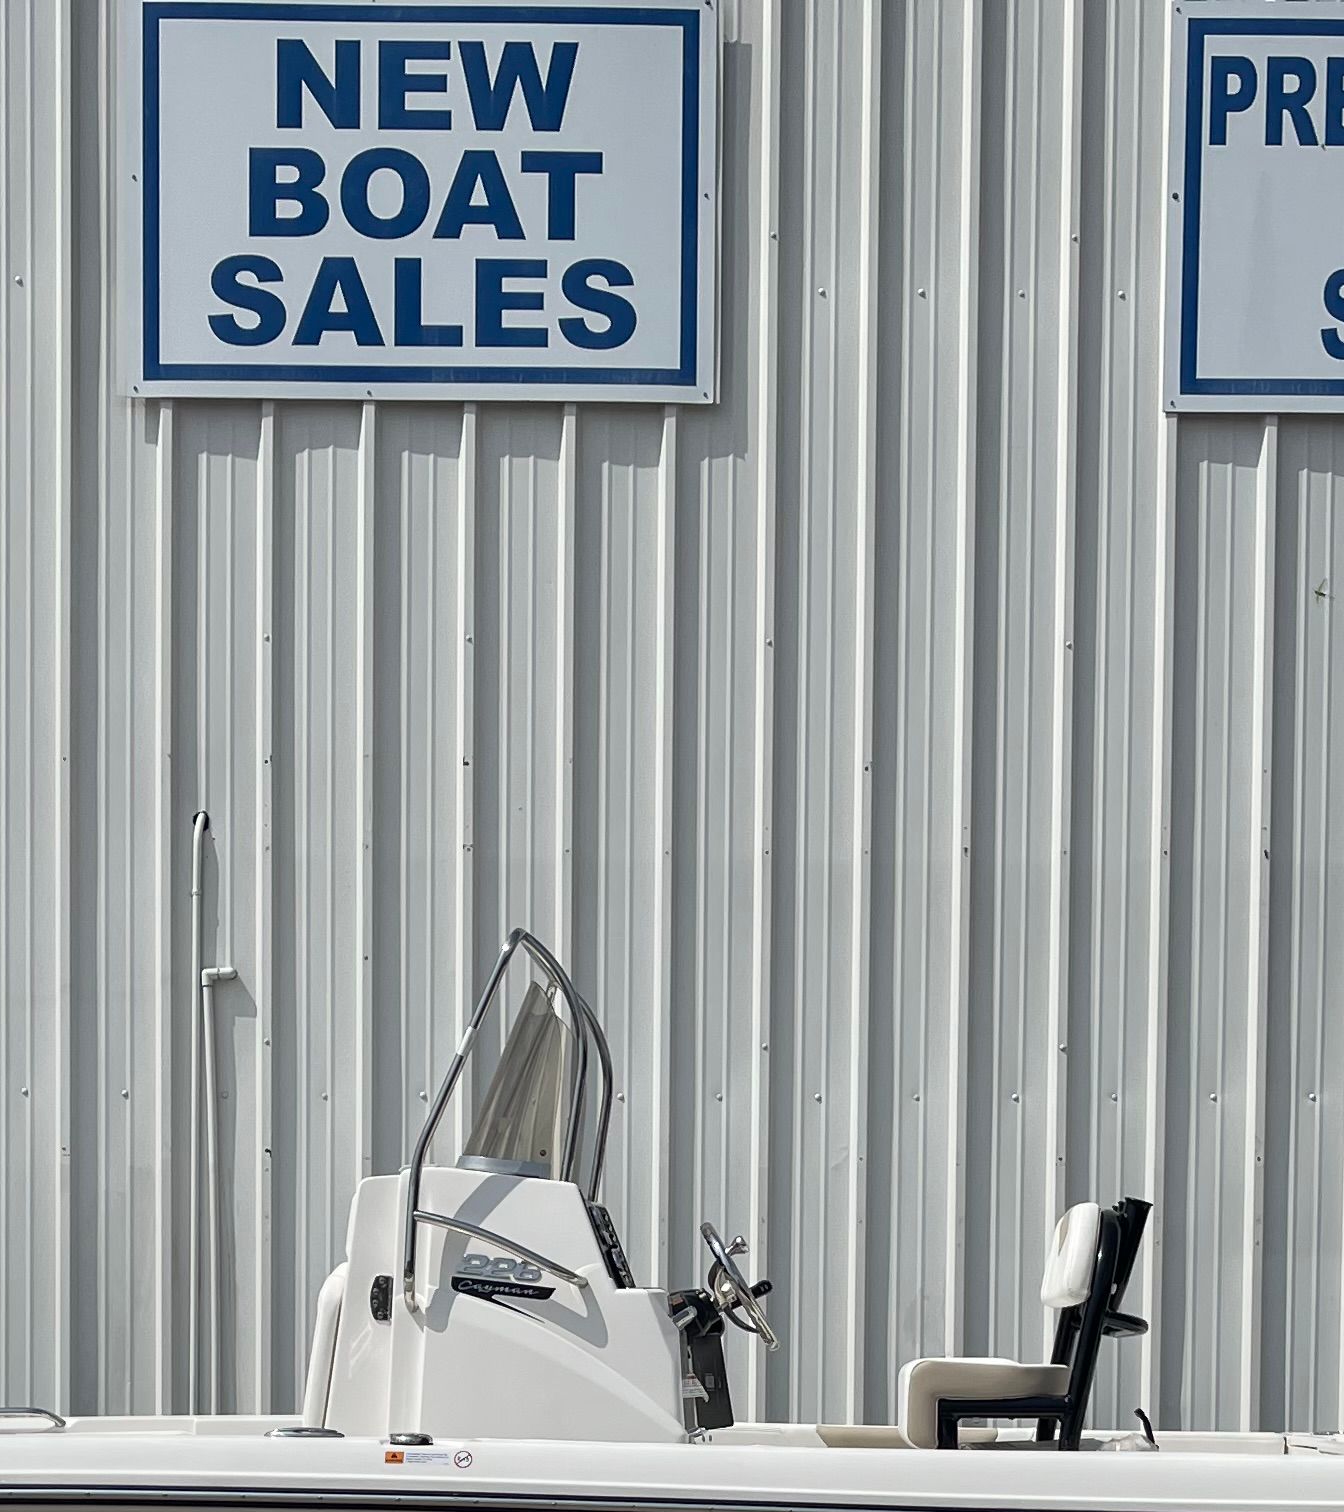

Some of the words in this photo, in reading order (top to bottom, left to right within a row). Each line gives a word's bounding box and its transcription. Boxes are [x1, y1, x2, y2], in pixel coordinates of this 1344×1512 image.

[275, 38, 580, 132] NEW
[248, 147, 604, 241] BOAT
[207, 254, 638, 350] SALES
